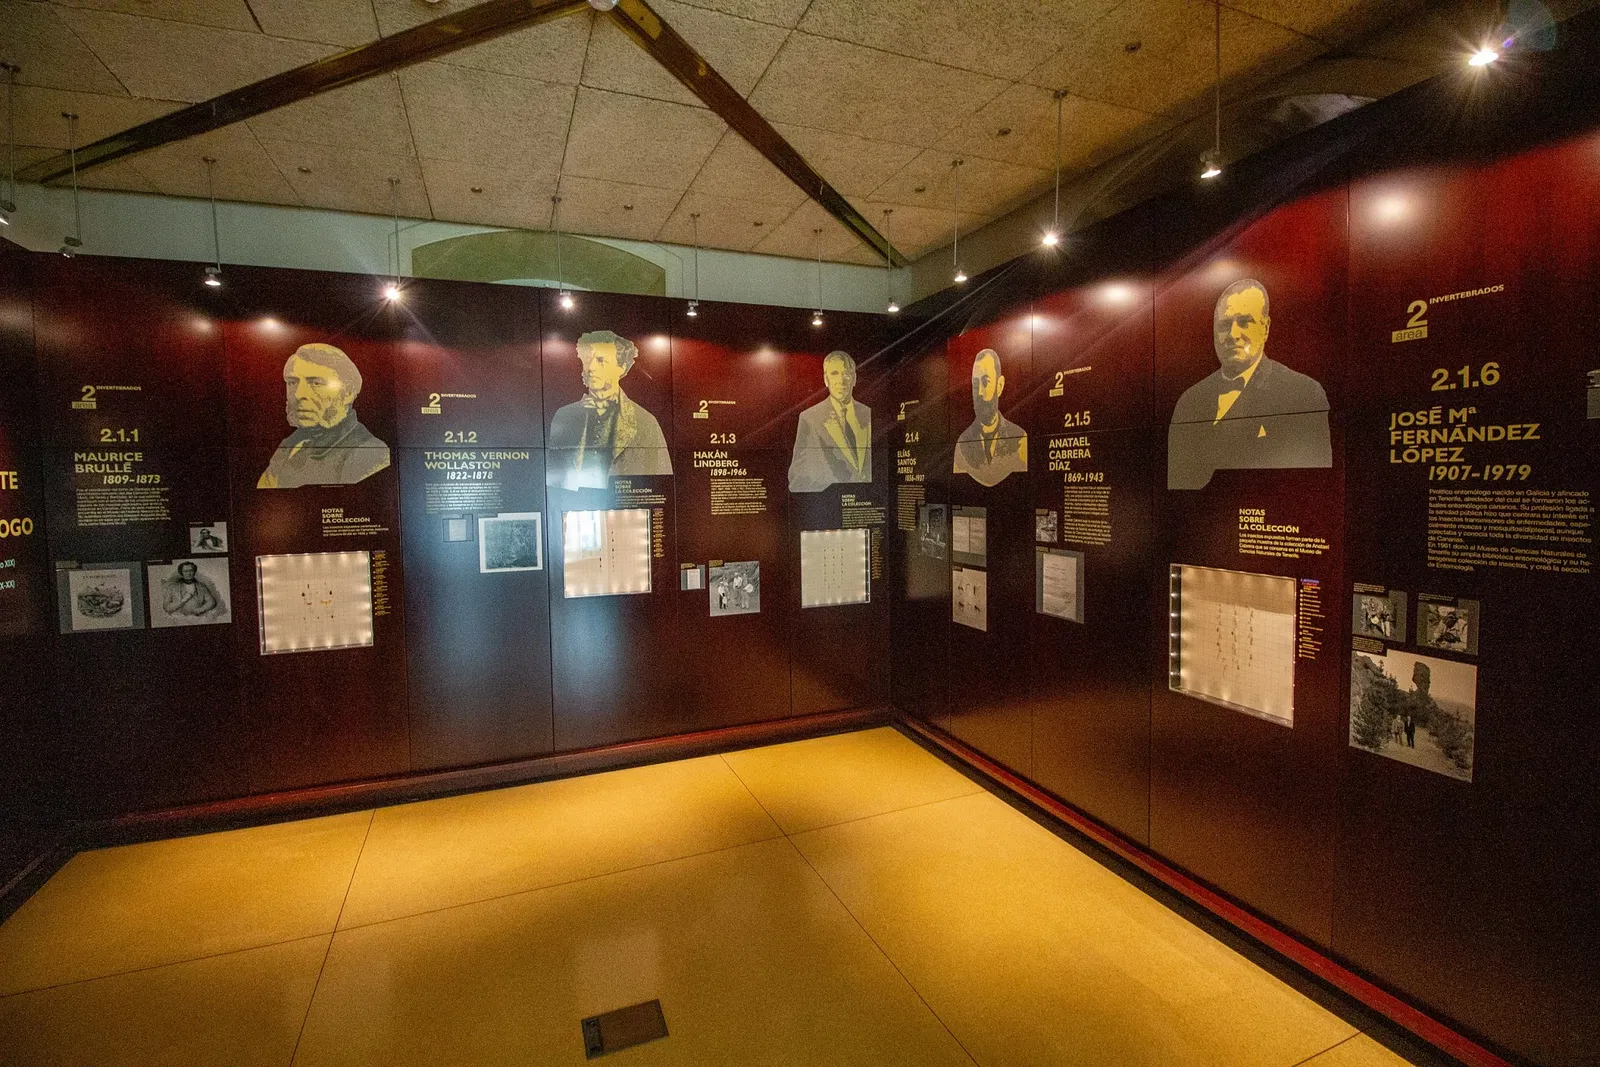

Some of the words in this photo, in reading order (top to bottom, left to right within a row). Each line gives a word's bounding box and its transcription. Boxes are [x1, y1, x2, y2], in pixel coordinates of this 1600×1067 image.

[1406, 300, 1428, 328] 2
[1429, 284, 1504, 304] INVERTEBRADOS
[1055, 372, 1063, 388] 2
[1431, 362, 1500, 391] 2.1.6
[82, 385, 96, 401] 2
[429, 393, 440, 407] 2
[699, 400, 708, 412] 2
[900, 403, 905, 414] 2
[1064, 411, 1090, 427] 2.1.5
[1389, 406, 1442, 431] JOSÉ
[100, 428, 139, 442] 2.1.1
[444, 431, 477, 443] 2.1.2
[710, 433, 736, 444] 2.1.3
[905, 432, 919, 442] 2.1.4
[1390, 423, 1540, 445] FERNÁNDEZ
[1049, 437, 1090, 448] ANATAEL
[74, 453, 143, 462] MAURICE
[1049, 449, 1091, 459] CABRERA
[1390, 445, 1464, 463] LÓPEZ
[75, 462, 132, 473] BRULLÉ
[424, 462, 500, 470] WOLLASTON
[1049, 460, 1070, 470] DÍAZ
[447, 471, 494, 480] 1822-1878
[1064, 473, 1103, 482] 1869-1943
[1429, 465, 1531, 481] 1907-1979
[0, 471, 18, 490] TE
[103, 475, 160, 484] 1809-1873
[0, 518, 33, 538] OGO
[1250, 524, 1299, 533] COLECCIÓN
